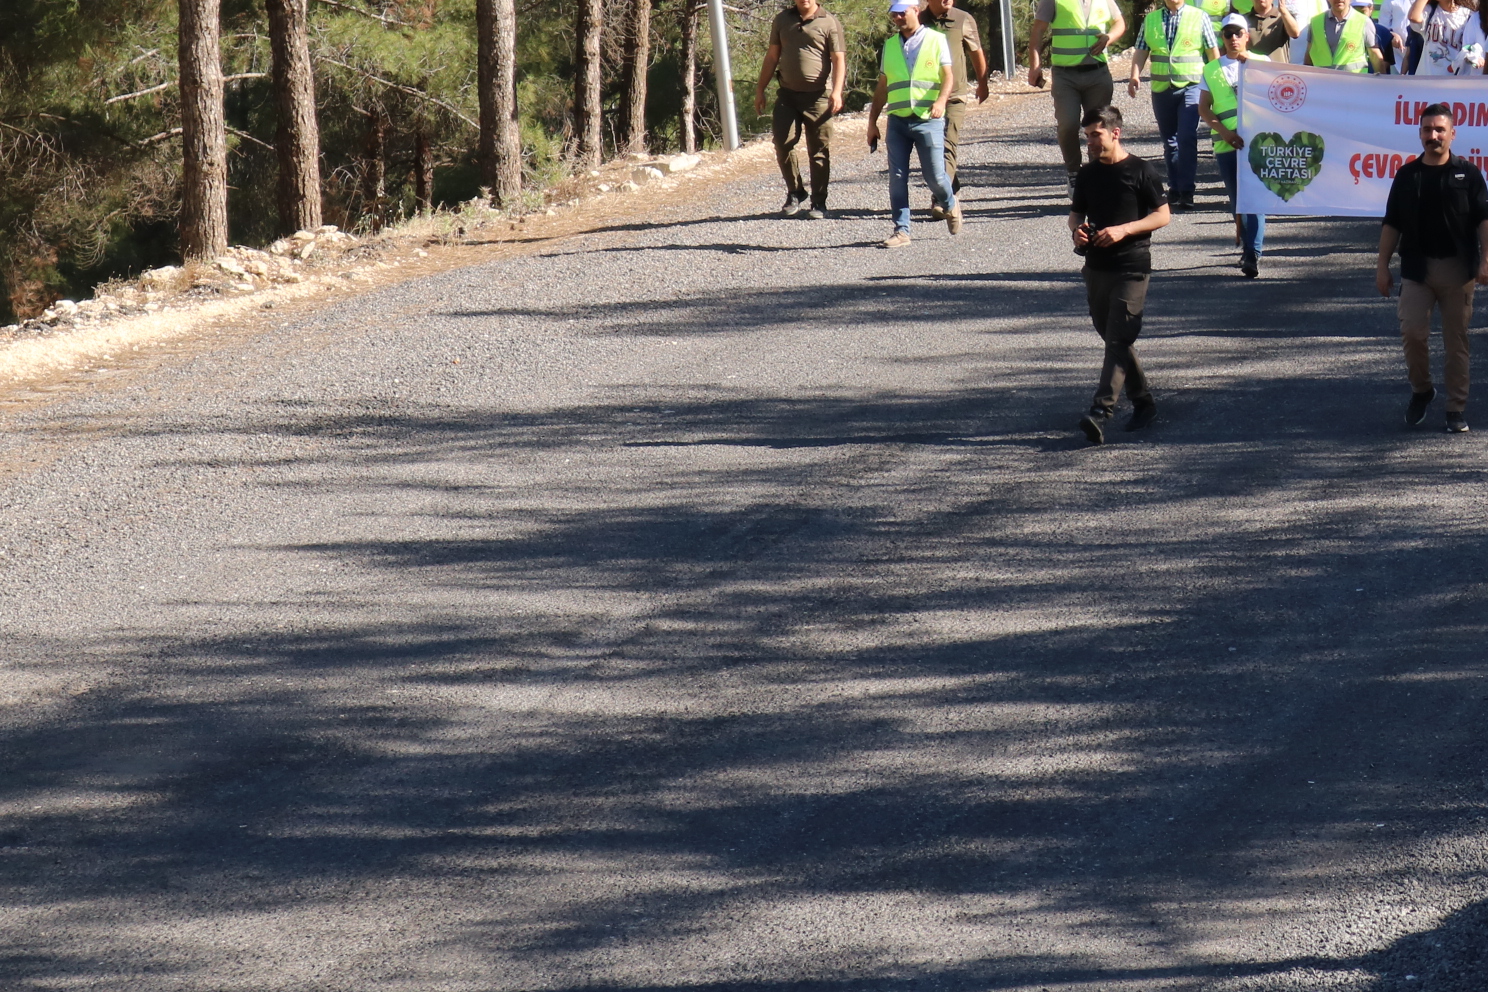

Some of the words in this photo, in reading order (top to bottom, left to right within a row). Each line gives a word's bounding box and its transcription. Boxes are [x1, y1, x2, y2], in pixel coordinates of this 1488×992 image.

[1260, 144, 1312, 157] TÜRKİYE
[1266, 157, 1307, 168] ÇEVRE
[1260, 168, 1312, 179] HAFTASI
